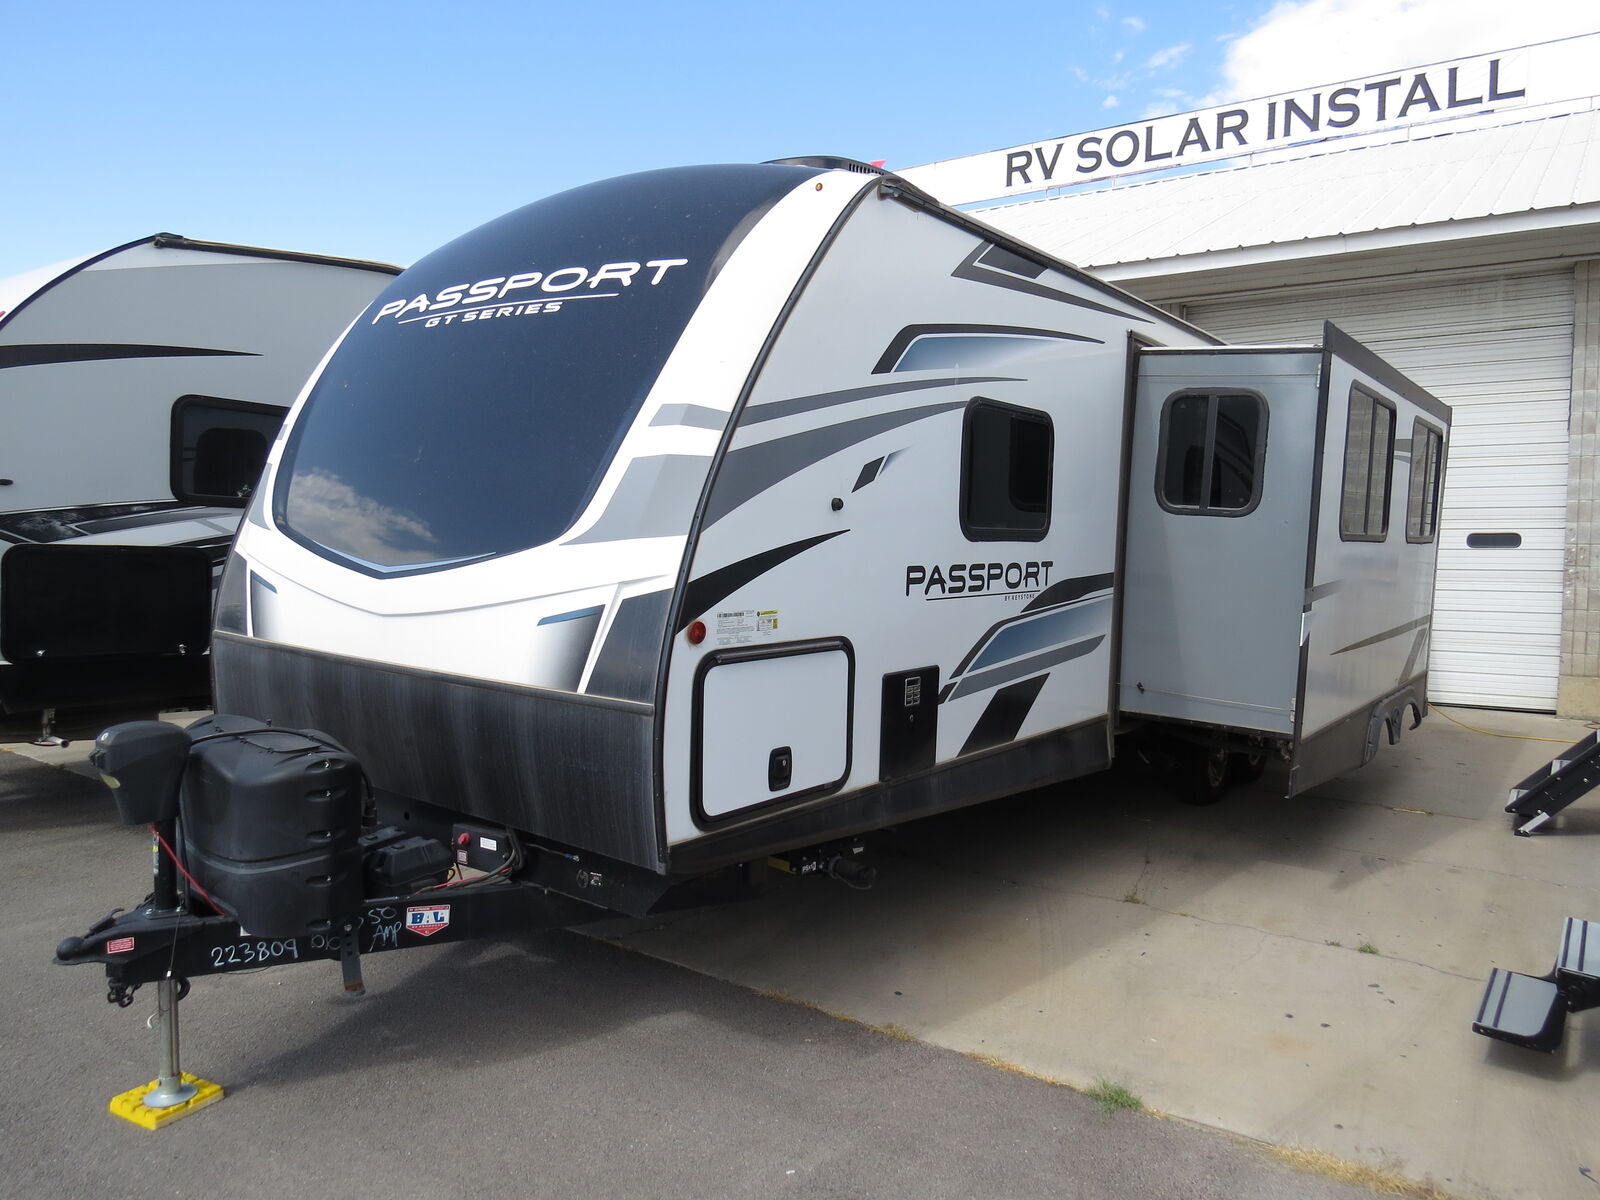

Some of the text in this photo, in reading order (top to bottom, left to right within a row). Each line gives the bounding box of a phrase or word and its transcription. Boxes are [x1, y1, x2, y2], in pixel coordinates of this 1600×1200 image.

[1005, 59, 1527, 187] RV SOLAR INSTALL
[371, 258, 689, 325] PASSPORT
[424, 301, 563, 328] GT SERIES
[905, 560, 1054, 597] PASSPORT
[367, 906, 397, 924] 50
[211, 938, 299, 967] 223809
[369, 921, 402, 953] AMP
